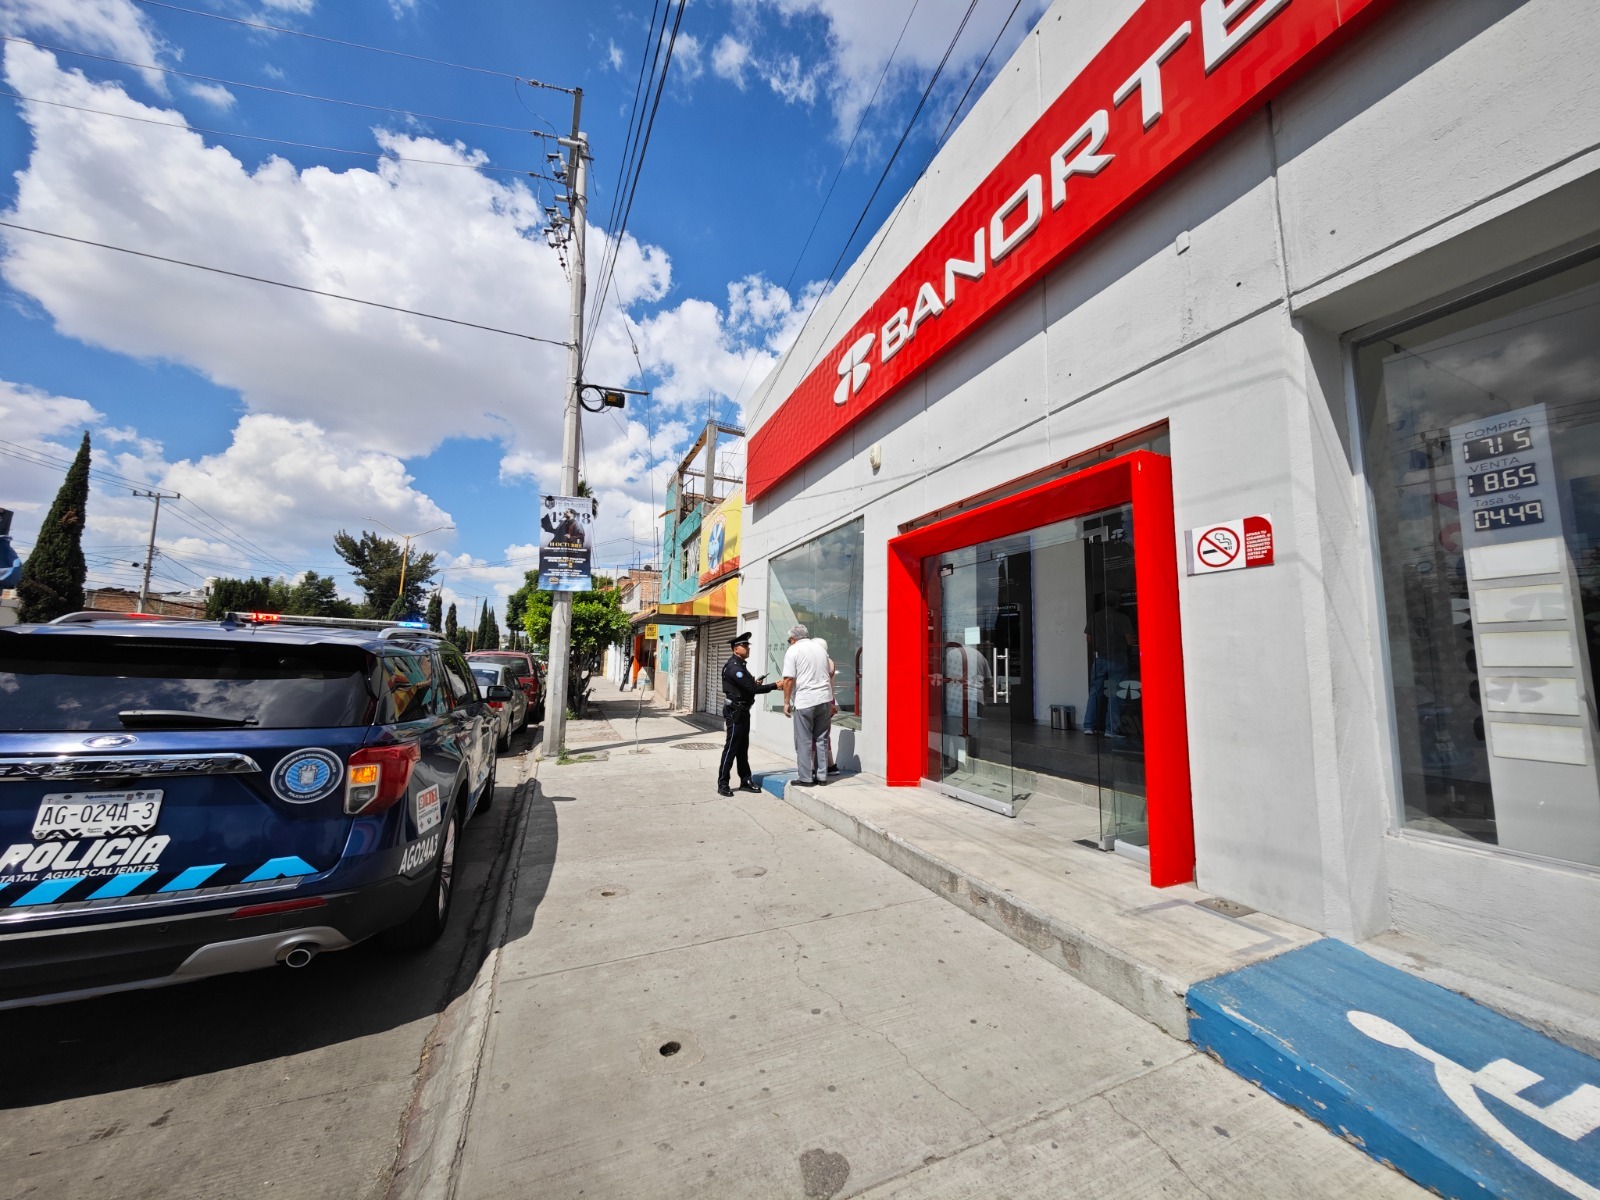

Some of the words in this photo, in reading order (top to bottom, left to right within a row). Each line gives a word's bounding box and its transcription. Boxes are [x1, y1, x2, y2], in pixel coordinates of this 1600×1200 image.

[880, 0, 1290, 363] BANORTE
[1465, 417, 1531, 439] COMPRA
[1469, 456, 1520, 473] VENTA
[1468, 465, 1536, 494] 18.65
[1474, 498, 1504, 508] Tasa
[1474, 502, 1543, 529] 04.49
[39, 803, 155, 826] AG-024A-3
[0, 835, 171, 873] POLICIA
[398, 834, 439, 876] AG024A3
[42, 864, 160, 881] AGUASCALIENTES
